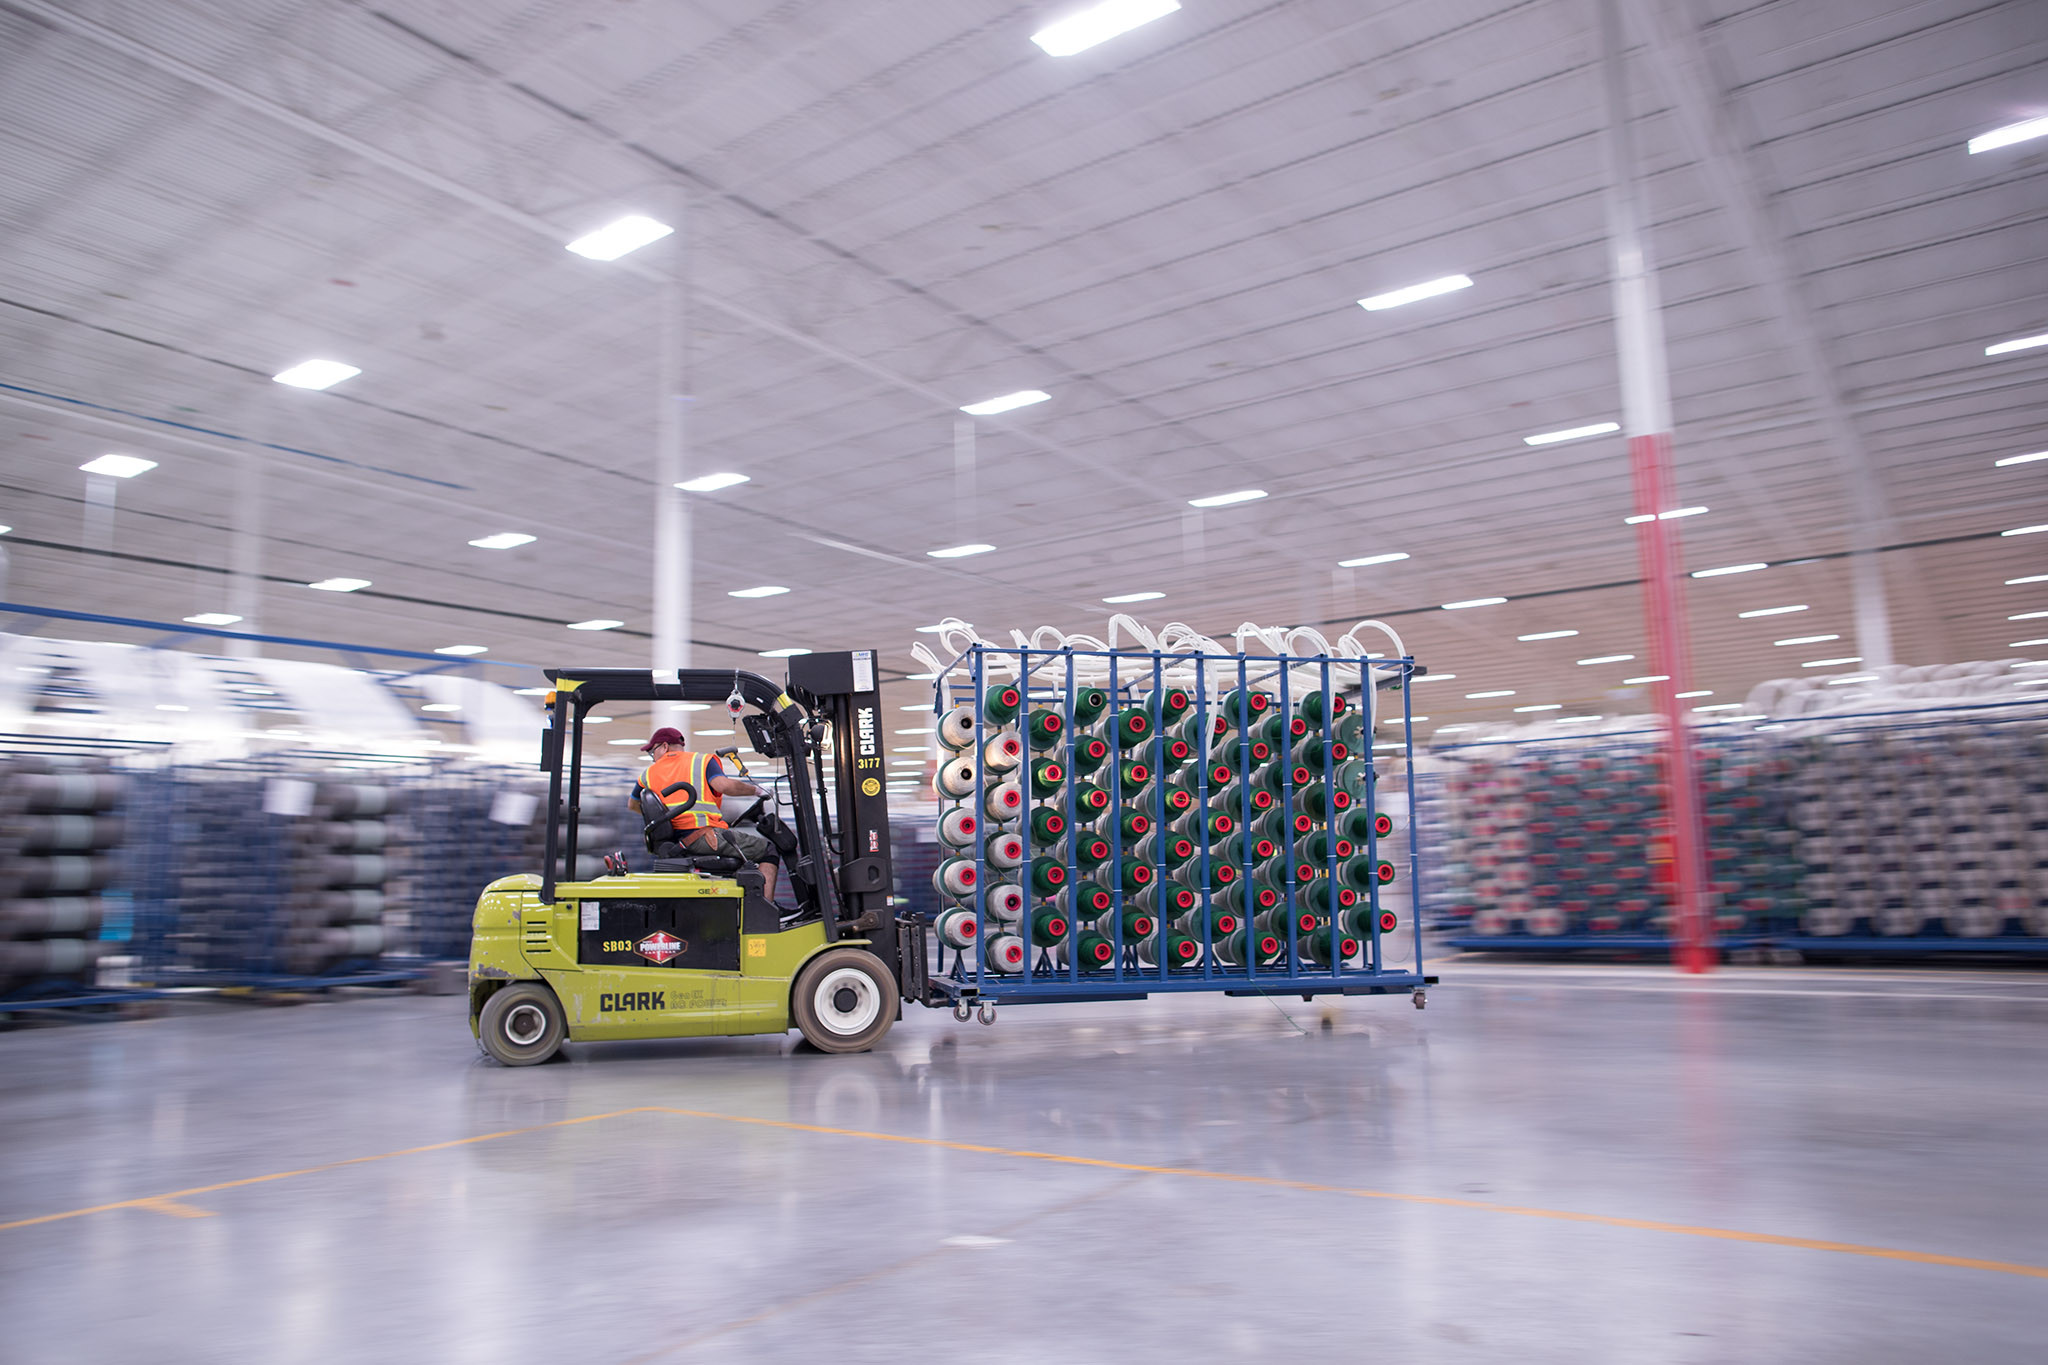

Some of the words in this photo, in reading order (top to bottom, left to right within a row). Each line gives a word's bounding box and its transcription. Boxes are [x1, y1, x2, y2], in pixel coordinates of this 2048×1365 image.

[858, 707, 875, 755] CLARK
[858, 757, 880, 769] 3177
[602, 940, 632, 952] SB03
[600, 991, 665, 1012] CLARK
